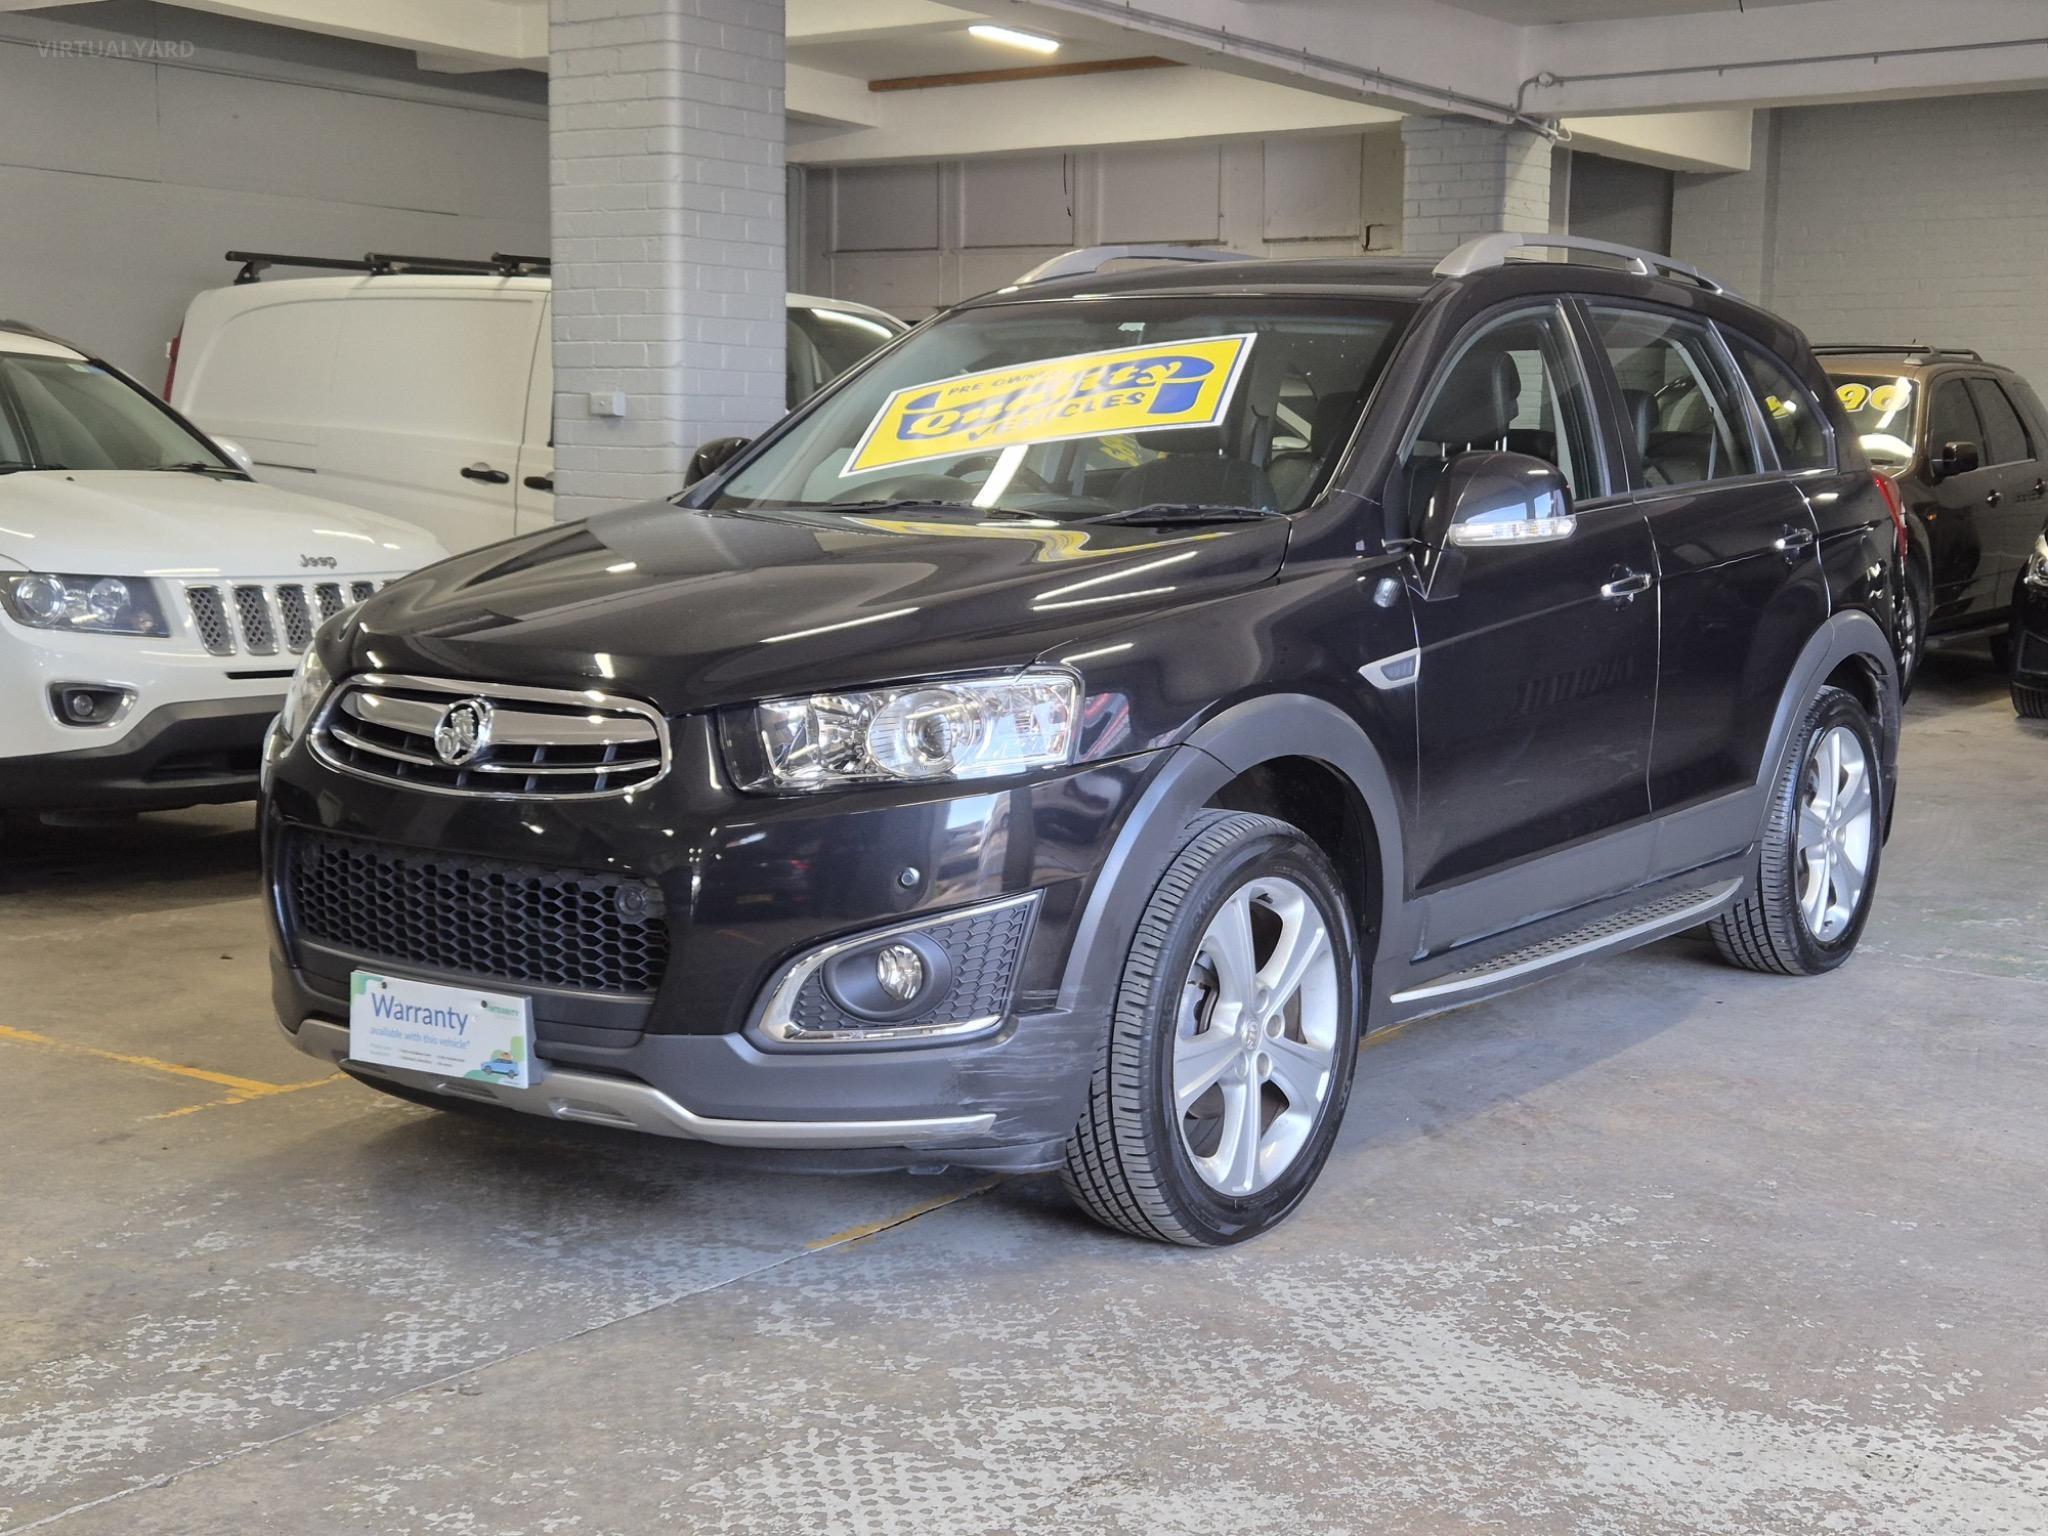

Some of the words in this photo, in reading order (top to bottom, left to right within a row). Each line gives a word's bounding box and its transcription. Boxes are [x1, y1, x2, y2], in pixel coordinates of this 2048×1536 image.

[948, 382, 984, 396] PRE
[299, 553, 338, 570] Jeep
[371, 993, 468, 1035] Warranty
[404, 1032, 422, 1042] with
[423, 1034, 439, 1045] this
